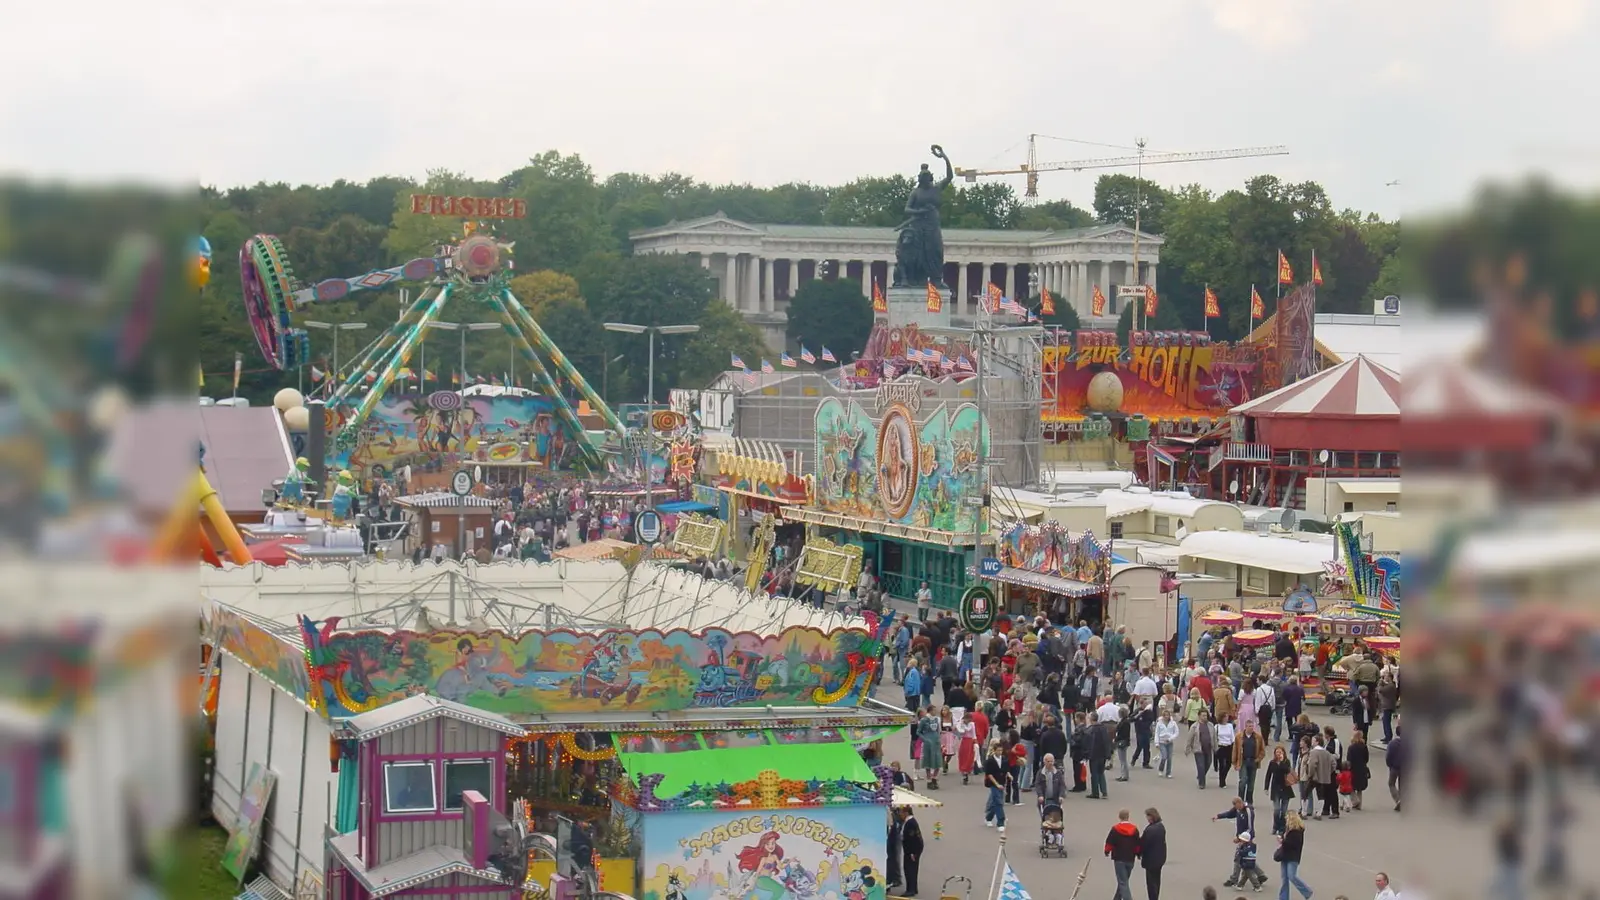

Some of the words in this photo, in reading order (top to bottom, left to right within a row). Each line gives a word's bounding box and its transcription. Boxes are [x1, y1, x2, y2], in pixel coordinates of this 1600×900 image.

[410, 193, 528, 219] FRISBEE
[1075, 344, 1121, 371] ZUR
[983, 561, 999, 571] WC
[689, 815, 764, 858] MAGIC
[770, 814, 851, 852] WORLD
